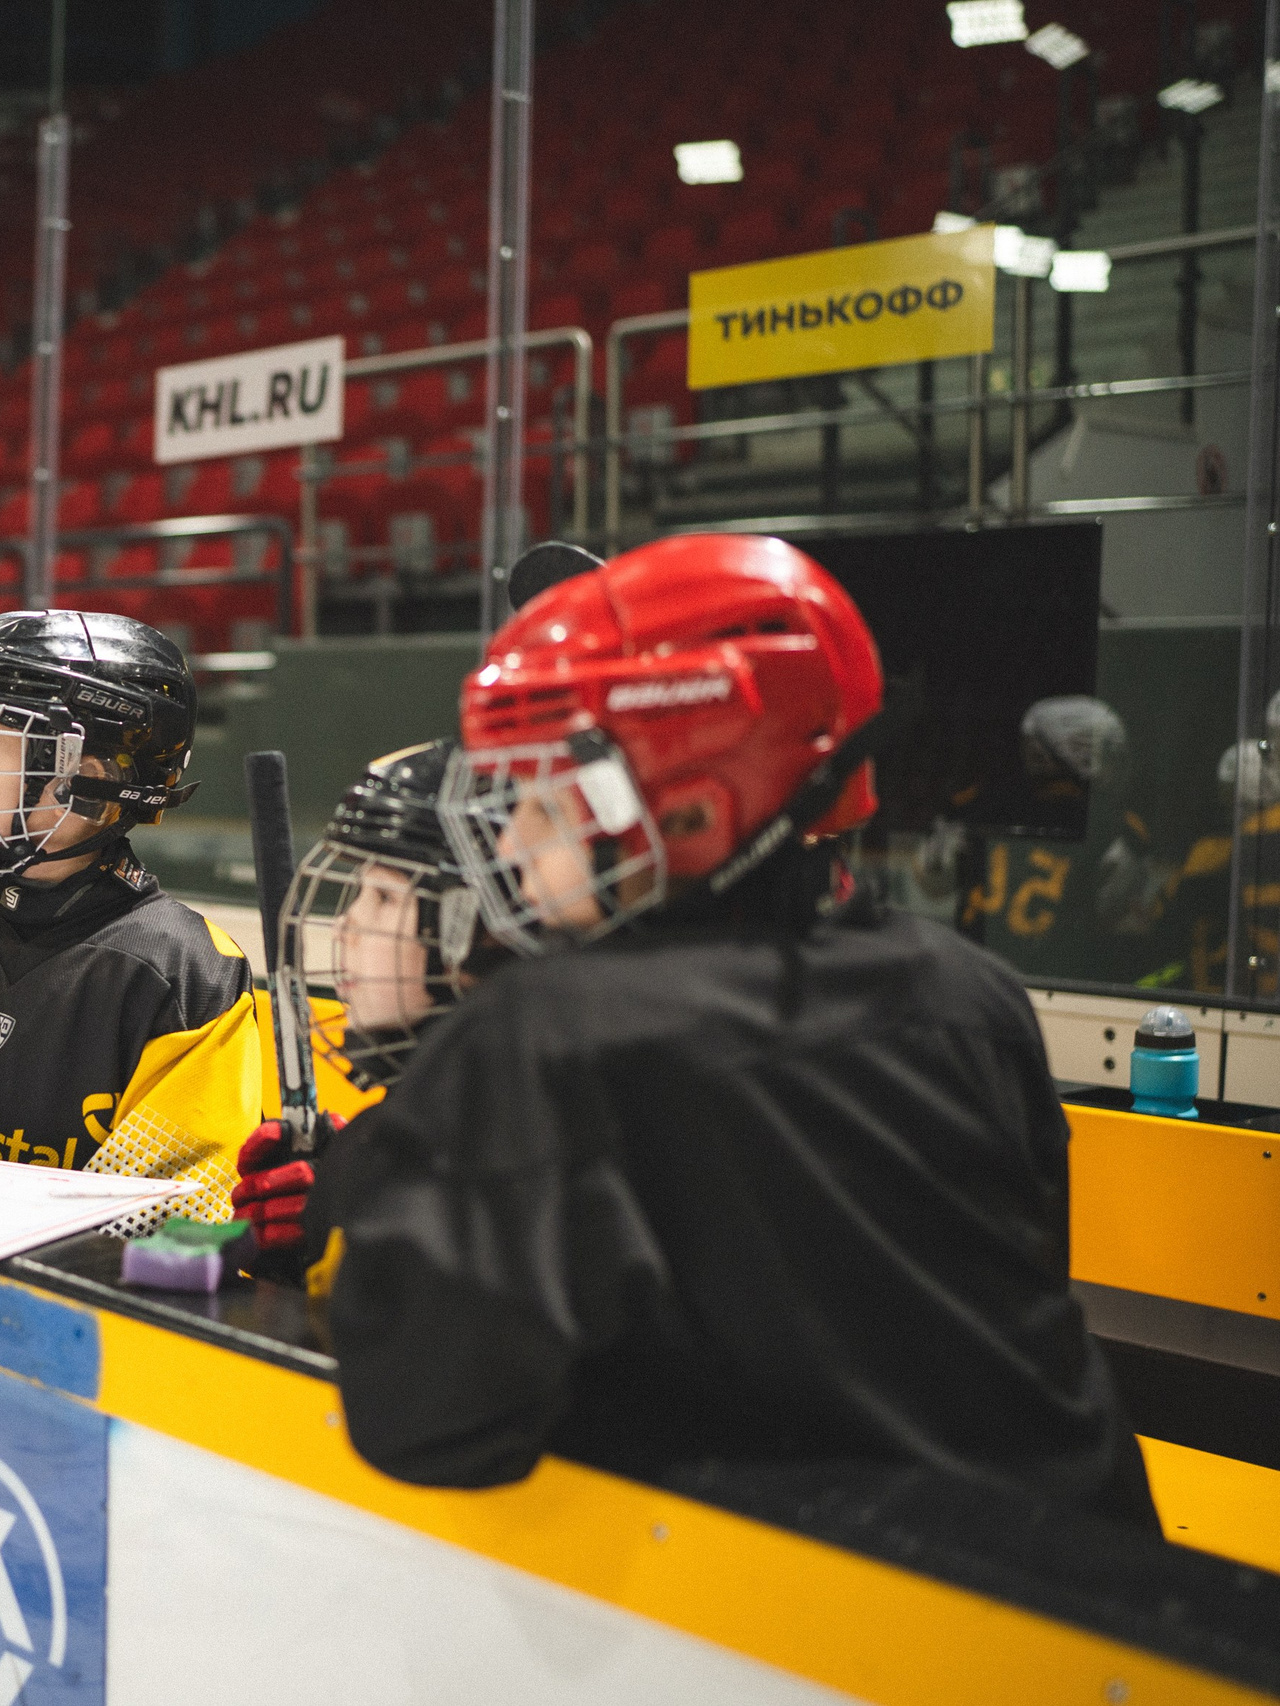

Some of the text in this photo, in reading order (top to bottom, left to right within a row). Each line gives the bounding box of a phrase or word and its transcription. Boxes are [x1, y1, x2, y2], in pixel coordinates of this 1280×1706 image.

[715, 278, 964, 341] ТИНЬКОФФ
[168, 362, 329, 437] KHL.RU
[76, 690, 144, 719] BAUER
